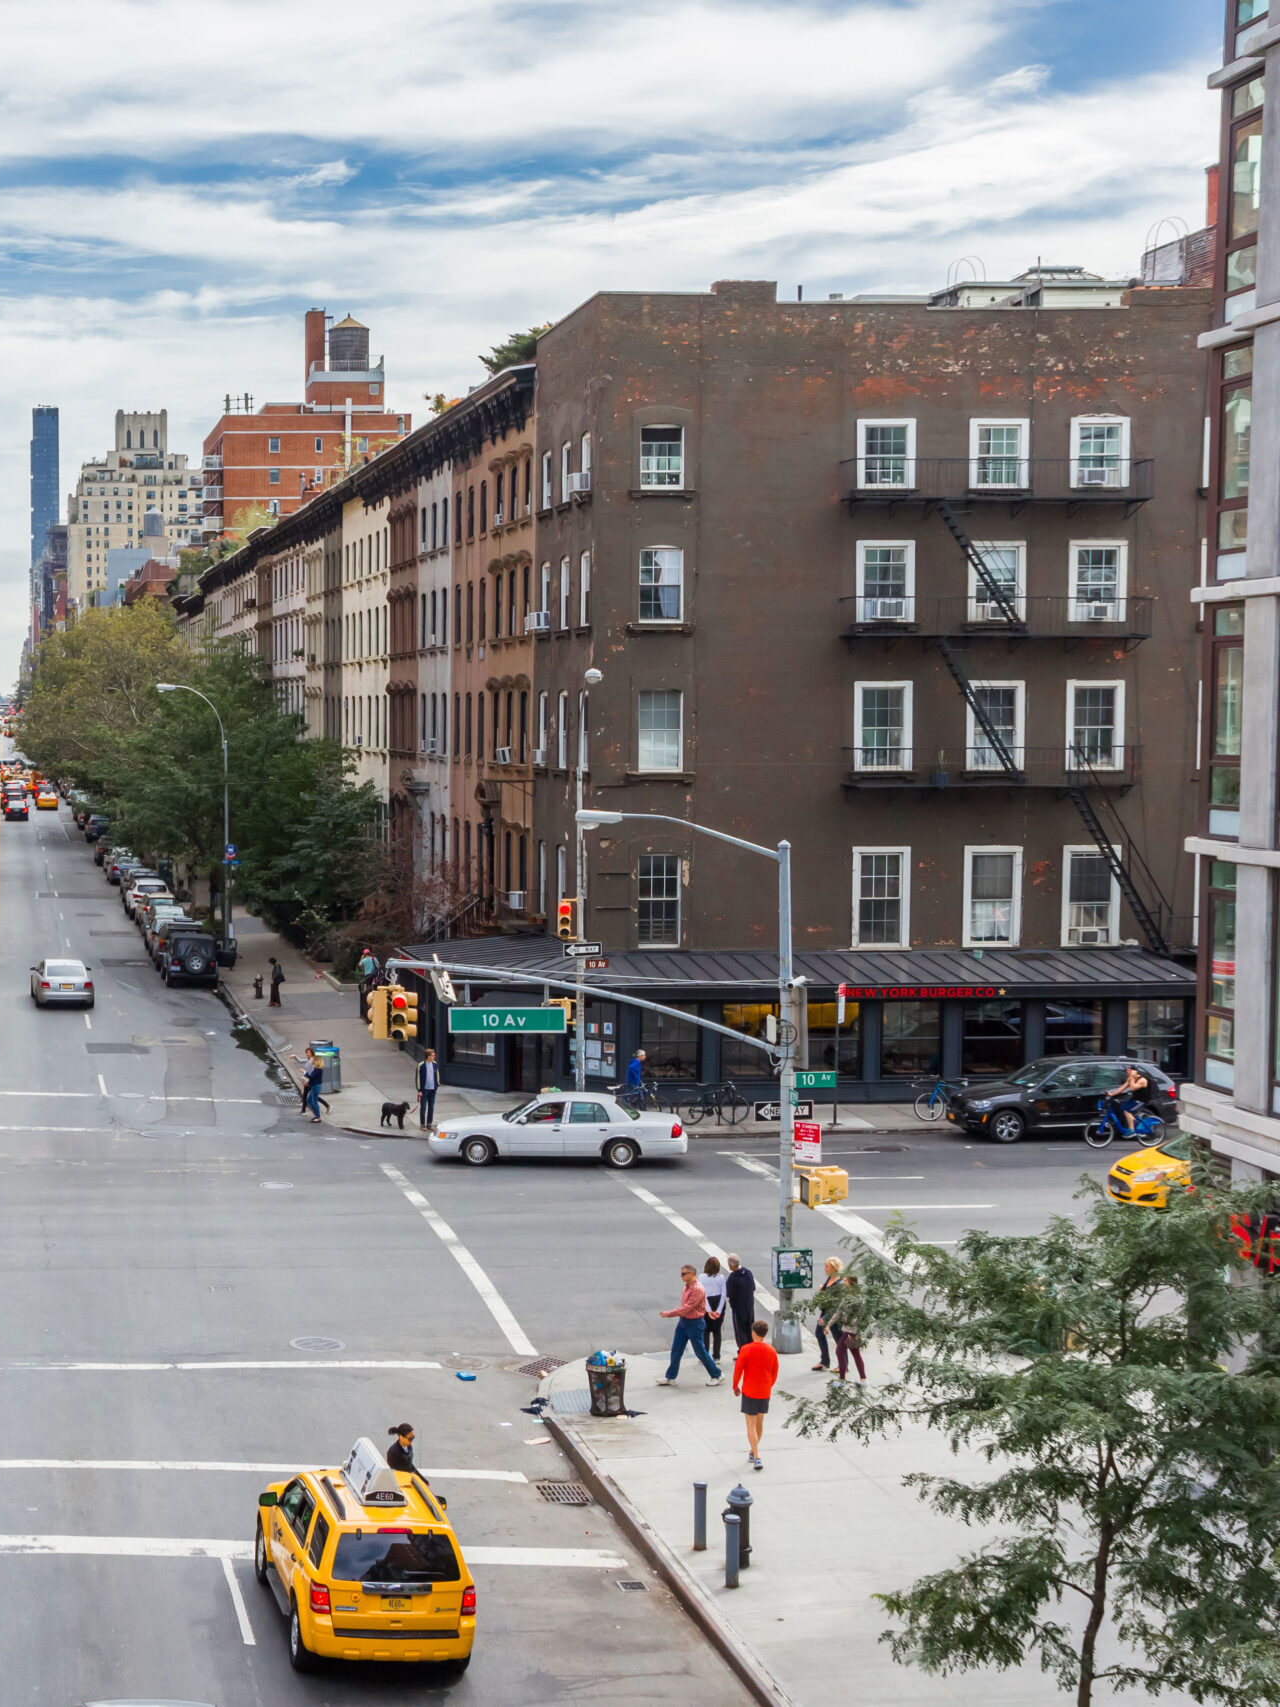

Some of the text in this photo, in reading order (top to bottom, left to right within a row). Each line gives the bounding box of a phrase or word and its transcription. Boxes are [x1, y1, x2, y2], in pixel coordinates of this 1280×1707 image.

[597, 960, 606, 968] Av
[845, 987, 877, 998] NEW
[881, 987, 917, 998] YORK
[920, 987, 972, 998] BURGER
[975, 987, 995, 998] CO
[482, 1014, 526, 1027] 10 Av
[802, 1074, 815, 1086] 10
[763, 1107, 780, 1116] ONE
[375, 1492, 394, 1501] 4E60
